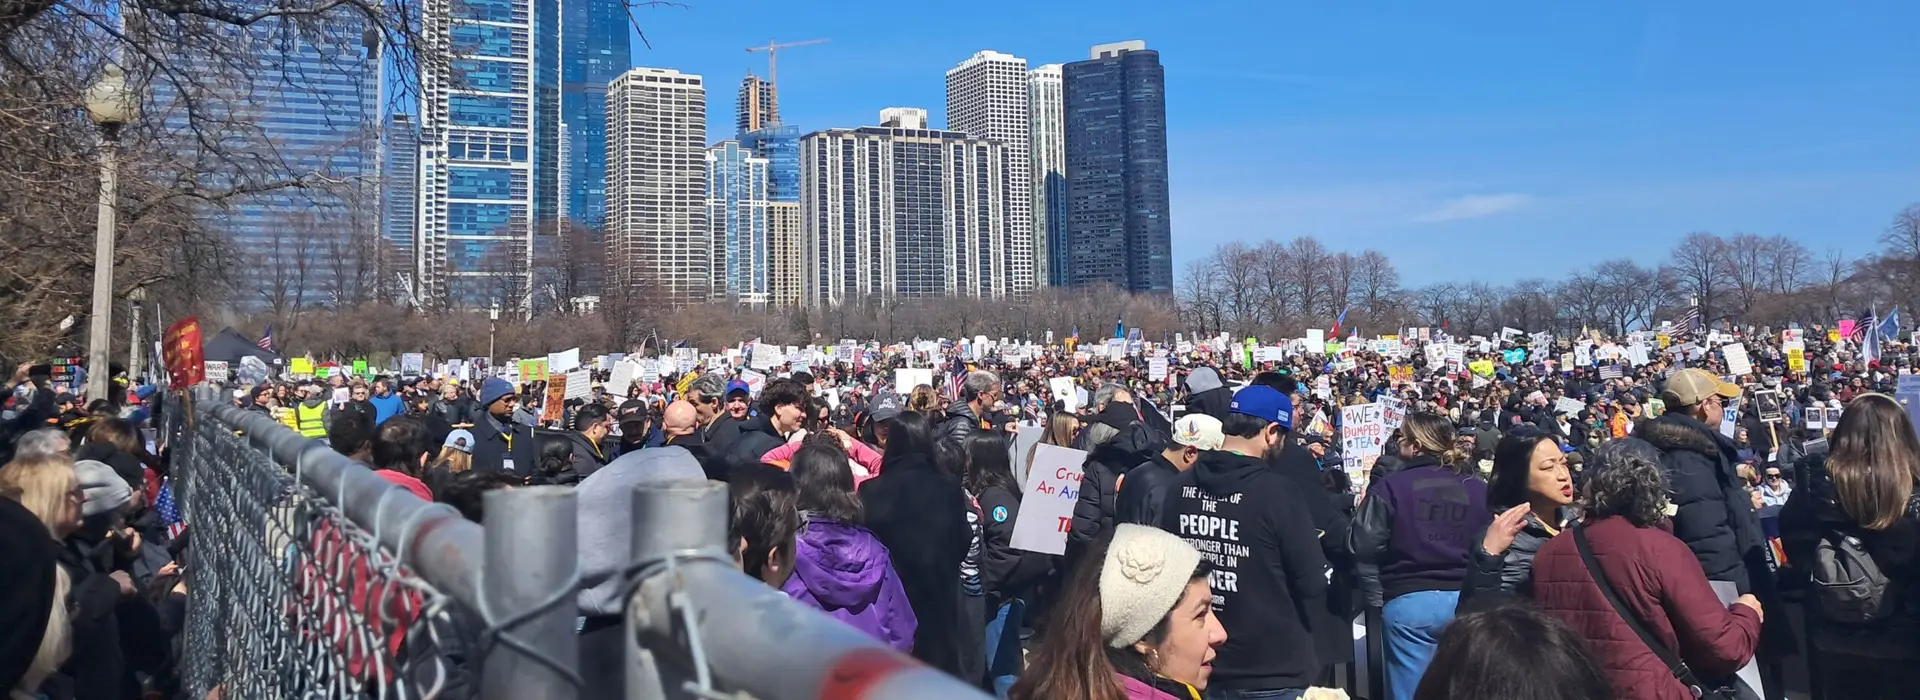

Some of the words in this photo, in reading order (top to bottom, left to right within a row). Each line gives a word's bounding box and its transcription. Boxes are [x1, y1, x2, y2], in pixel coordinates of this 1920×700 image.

[1351, 405, 1374, 425] WE
[1343, 423, 1380, 439] DUMPED
[1353, 436, 1374, 449] TEA
[1036, 480, 1055, 495] An
[1182, 486, 1197, 499] THE
[1201, 499, 1218, 513] THE
[1180, 514, 1240, 541] PEOPLE
[1223, 542, 1250, 558] THAN
[1201, 552, 1225, 567] EOPLE
[1227, 555, 1238, 569] IN
